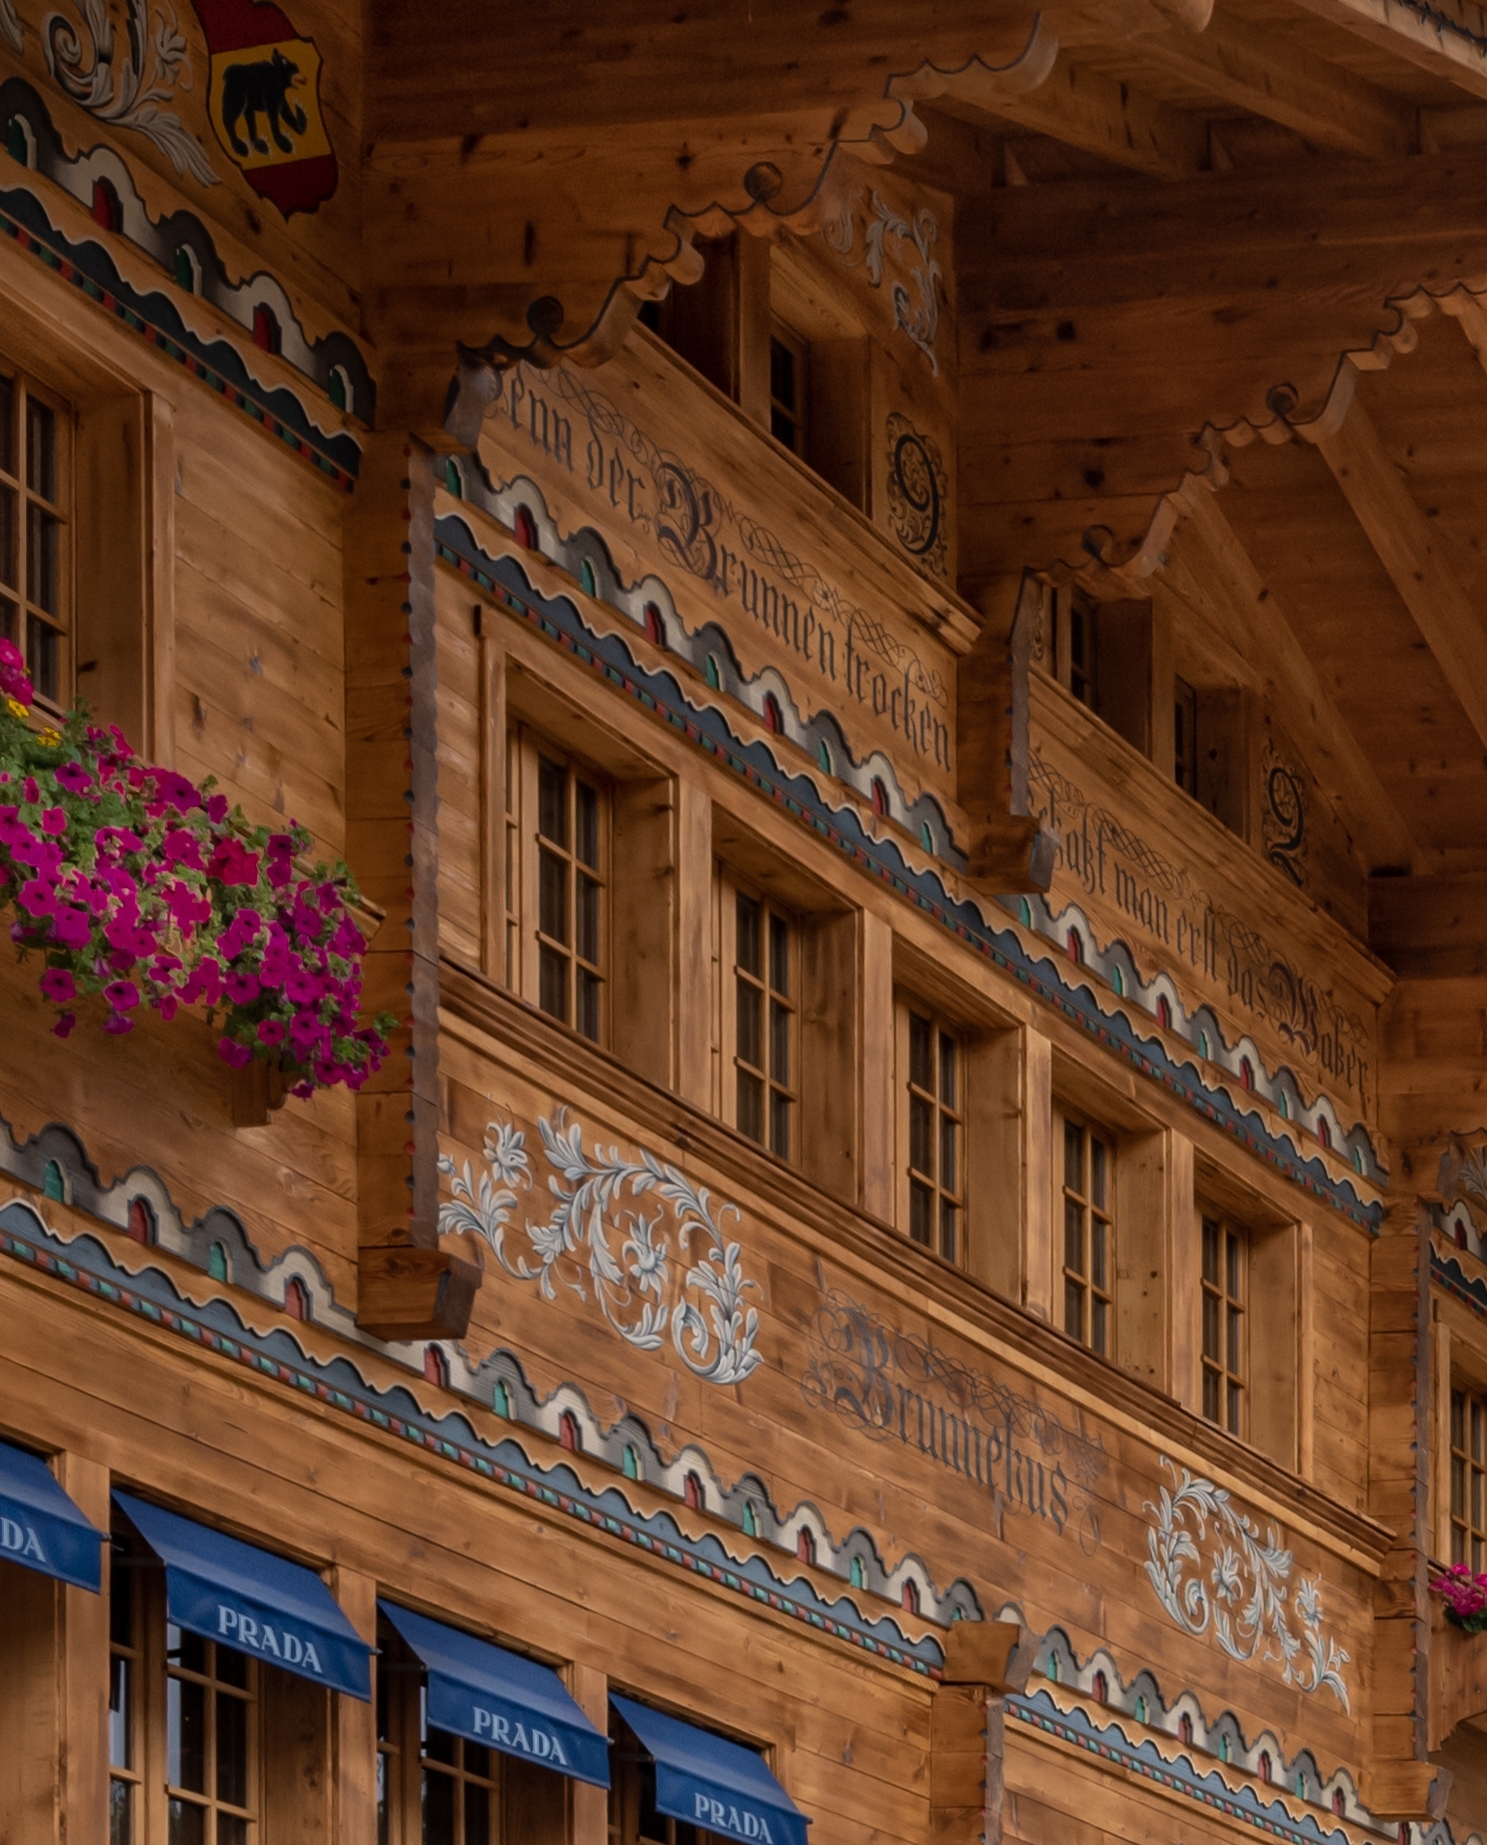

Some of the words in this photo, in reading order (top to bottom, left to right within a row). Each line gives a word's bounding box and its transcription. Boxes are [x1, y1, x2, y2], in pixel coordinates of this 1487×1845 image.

[498, 363, 572, 472] enn
[588, 427, 645, 522] der
[1114, 862, 1169, 944] man
[1227, 945, 1264, 1019] das
[216, 1604, 323, 1675] PRADA
[472, 1707, 568, 1766] PRADA
[693, 1791, 774, 1845] PRADA
